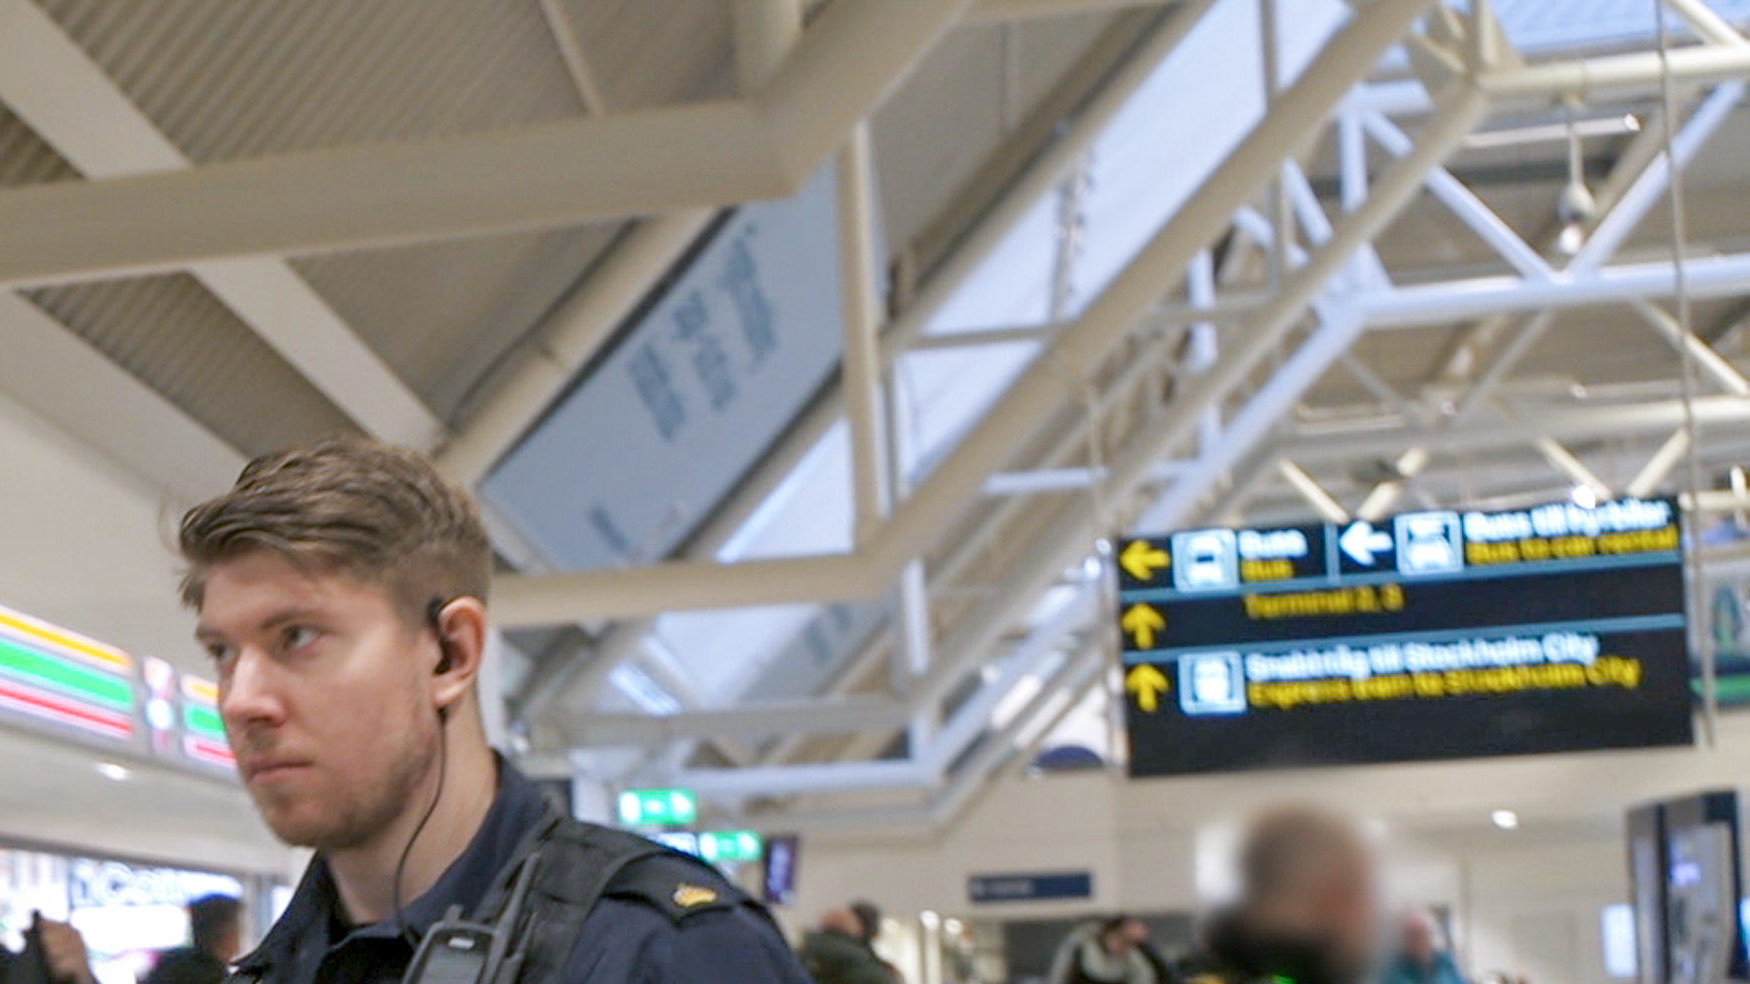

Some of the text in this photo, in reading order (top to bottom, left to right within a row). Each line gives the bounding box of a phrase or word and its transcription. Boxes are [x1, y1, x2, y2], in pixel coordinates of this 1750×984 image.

[1463, 511, 1531, 541] Buss
[1465, 541, 1519, 564] Bus
[1246, 588, 1353, 617] Terminal
[1404, 639, 1543, 670] Stockholm
[1543, 632, 1599, 664] City
[1248, 681, 1351, 709] Express
[1443, 664, 1585, 694] Stockholm
[1584, 655, 1639, 689] City
